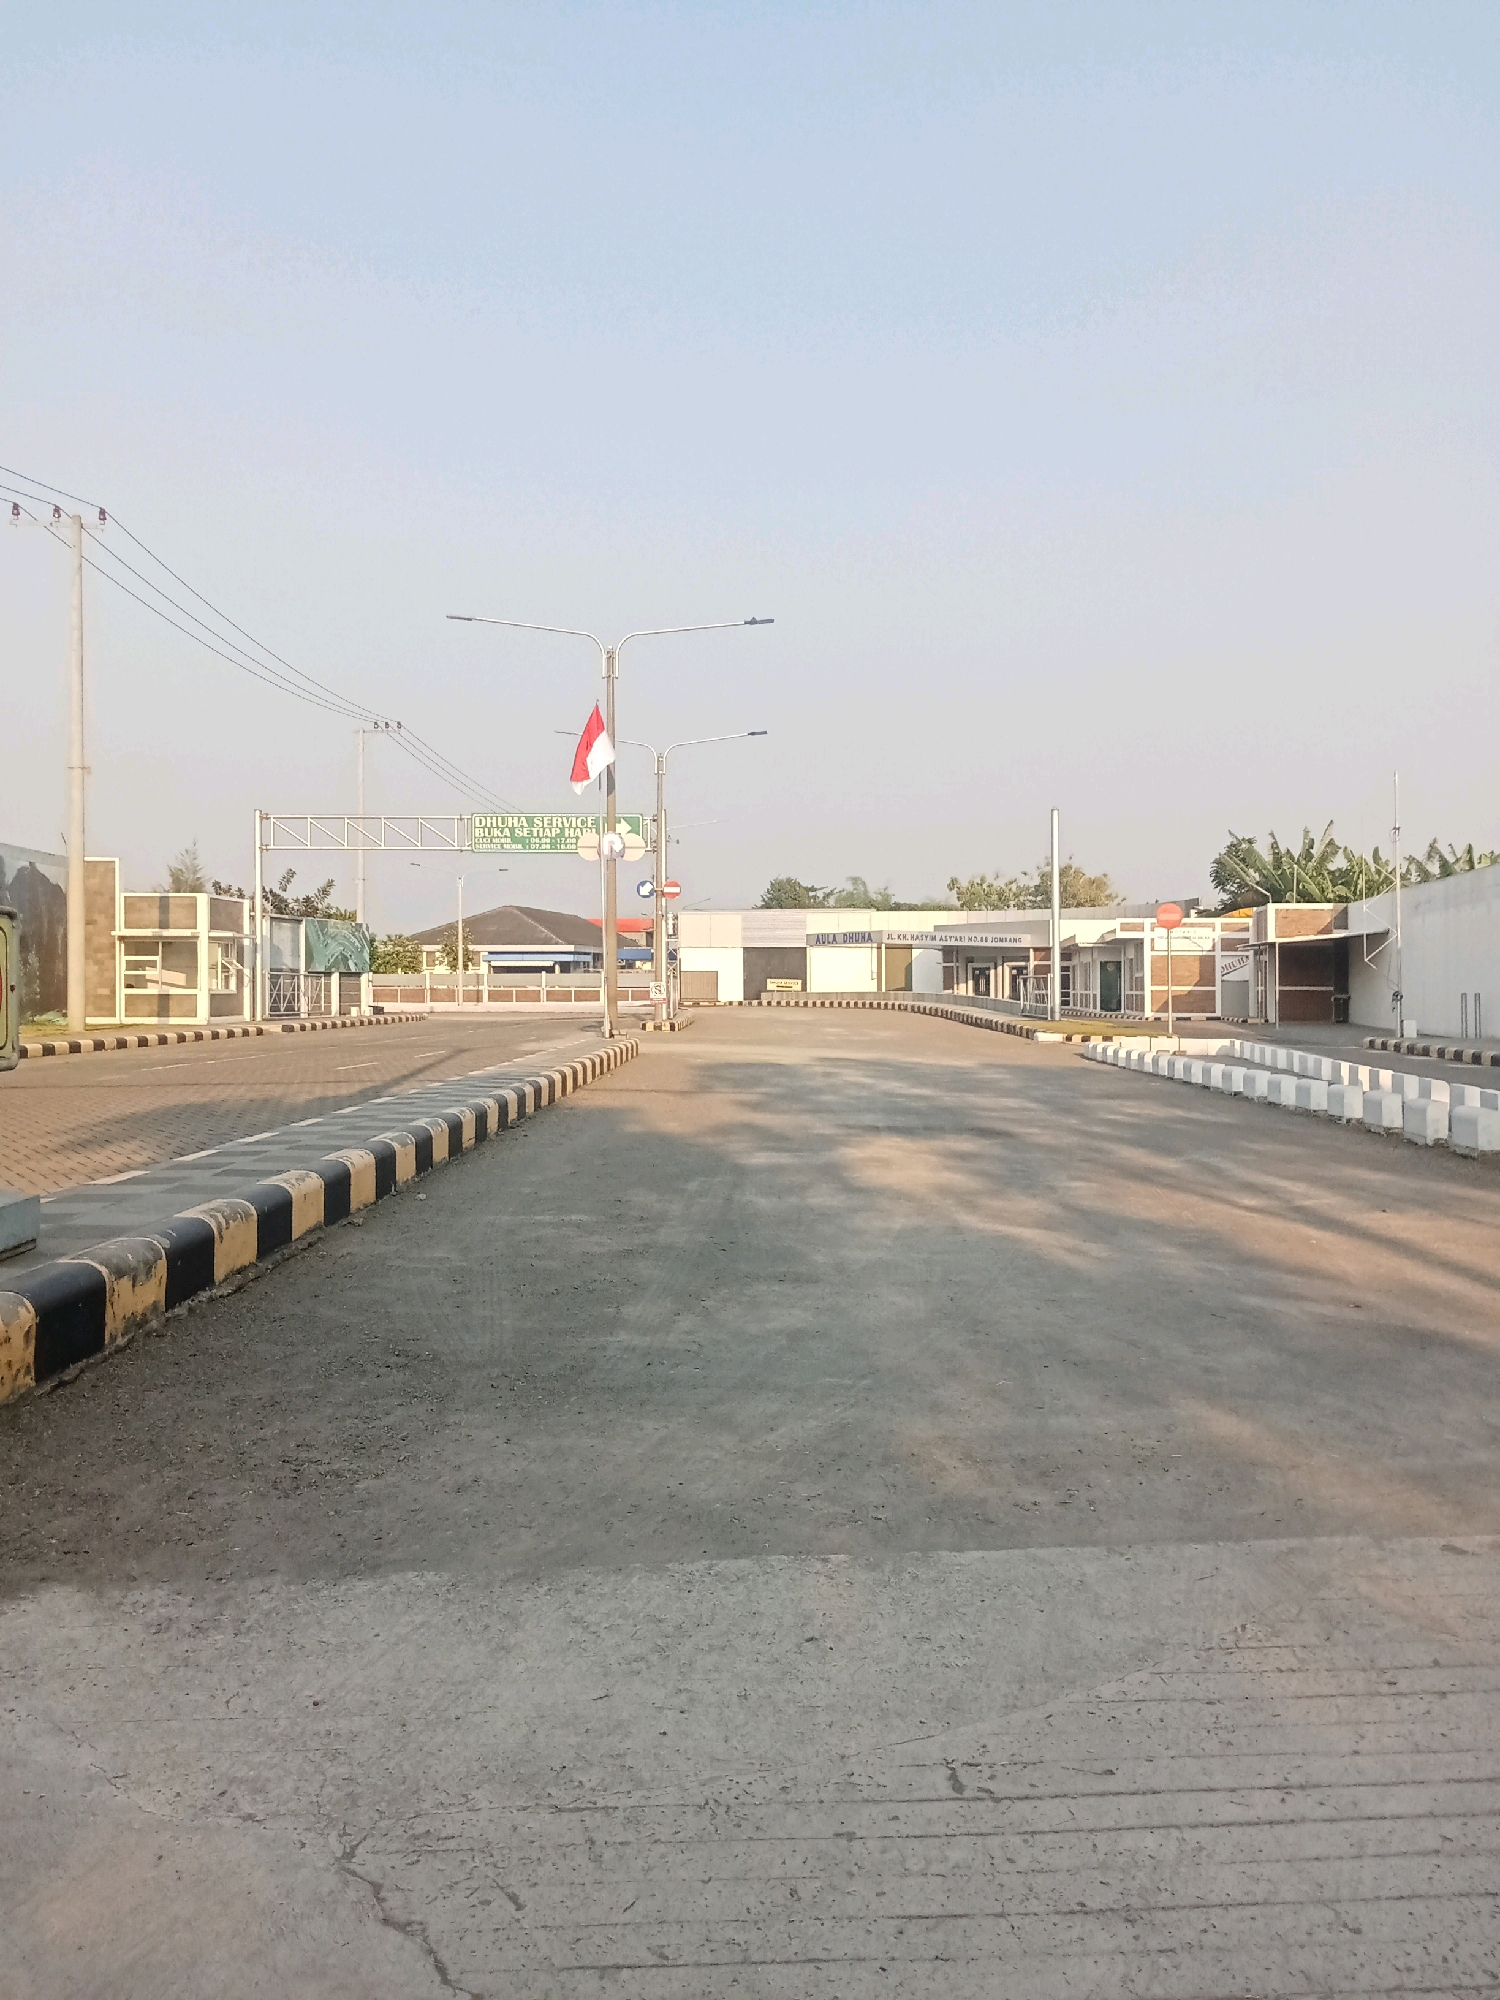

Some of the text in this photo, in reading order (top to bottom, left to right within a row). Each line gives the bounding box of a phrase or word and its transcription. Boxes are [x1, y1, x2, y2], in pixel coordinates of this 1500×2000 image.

[475, 816, 597, 828] DHUHA SERVICE
[475, 827, 511, 837] BUKA
[515, 827, 561, 837] SETIAP
[815, 932, 873, 945] AULA DHUHA
[886, 933, 896, 941] JL.
[897, 933, 909, 941] KH.
[910, 933, 937, 942] HASYIM
[990, 936, 1022, 944] JOMBANG
